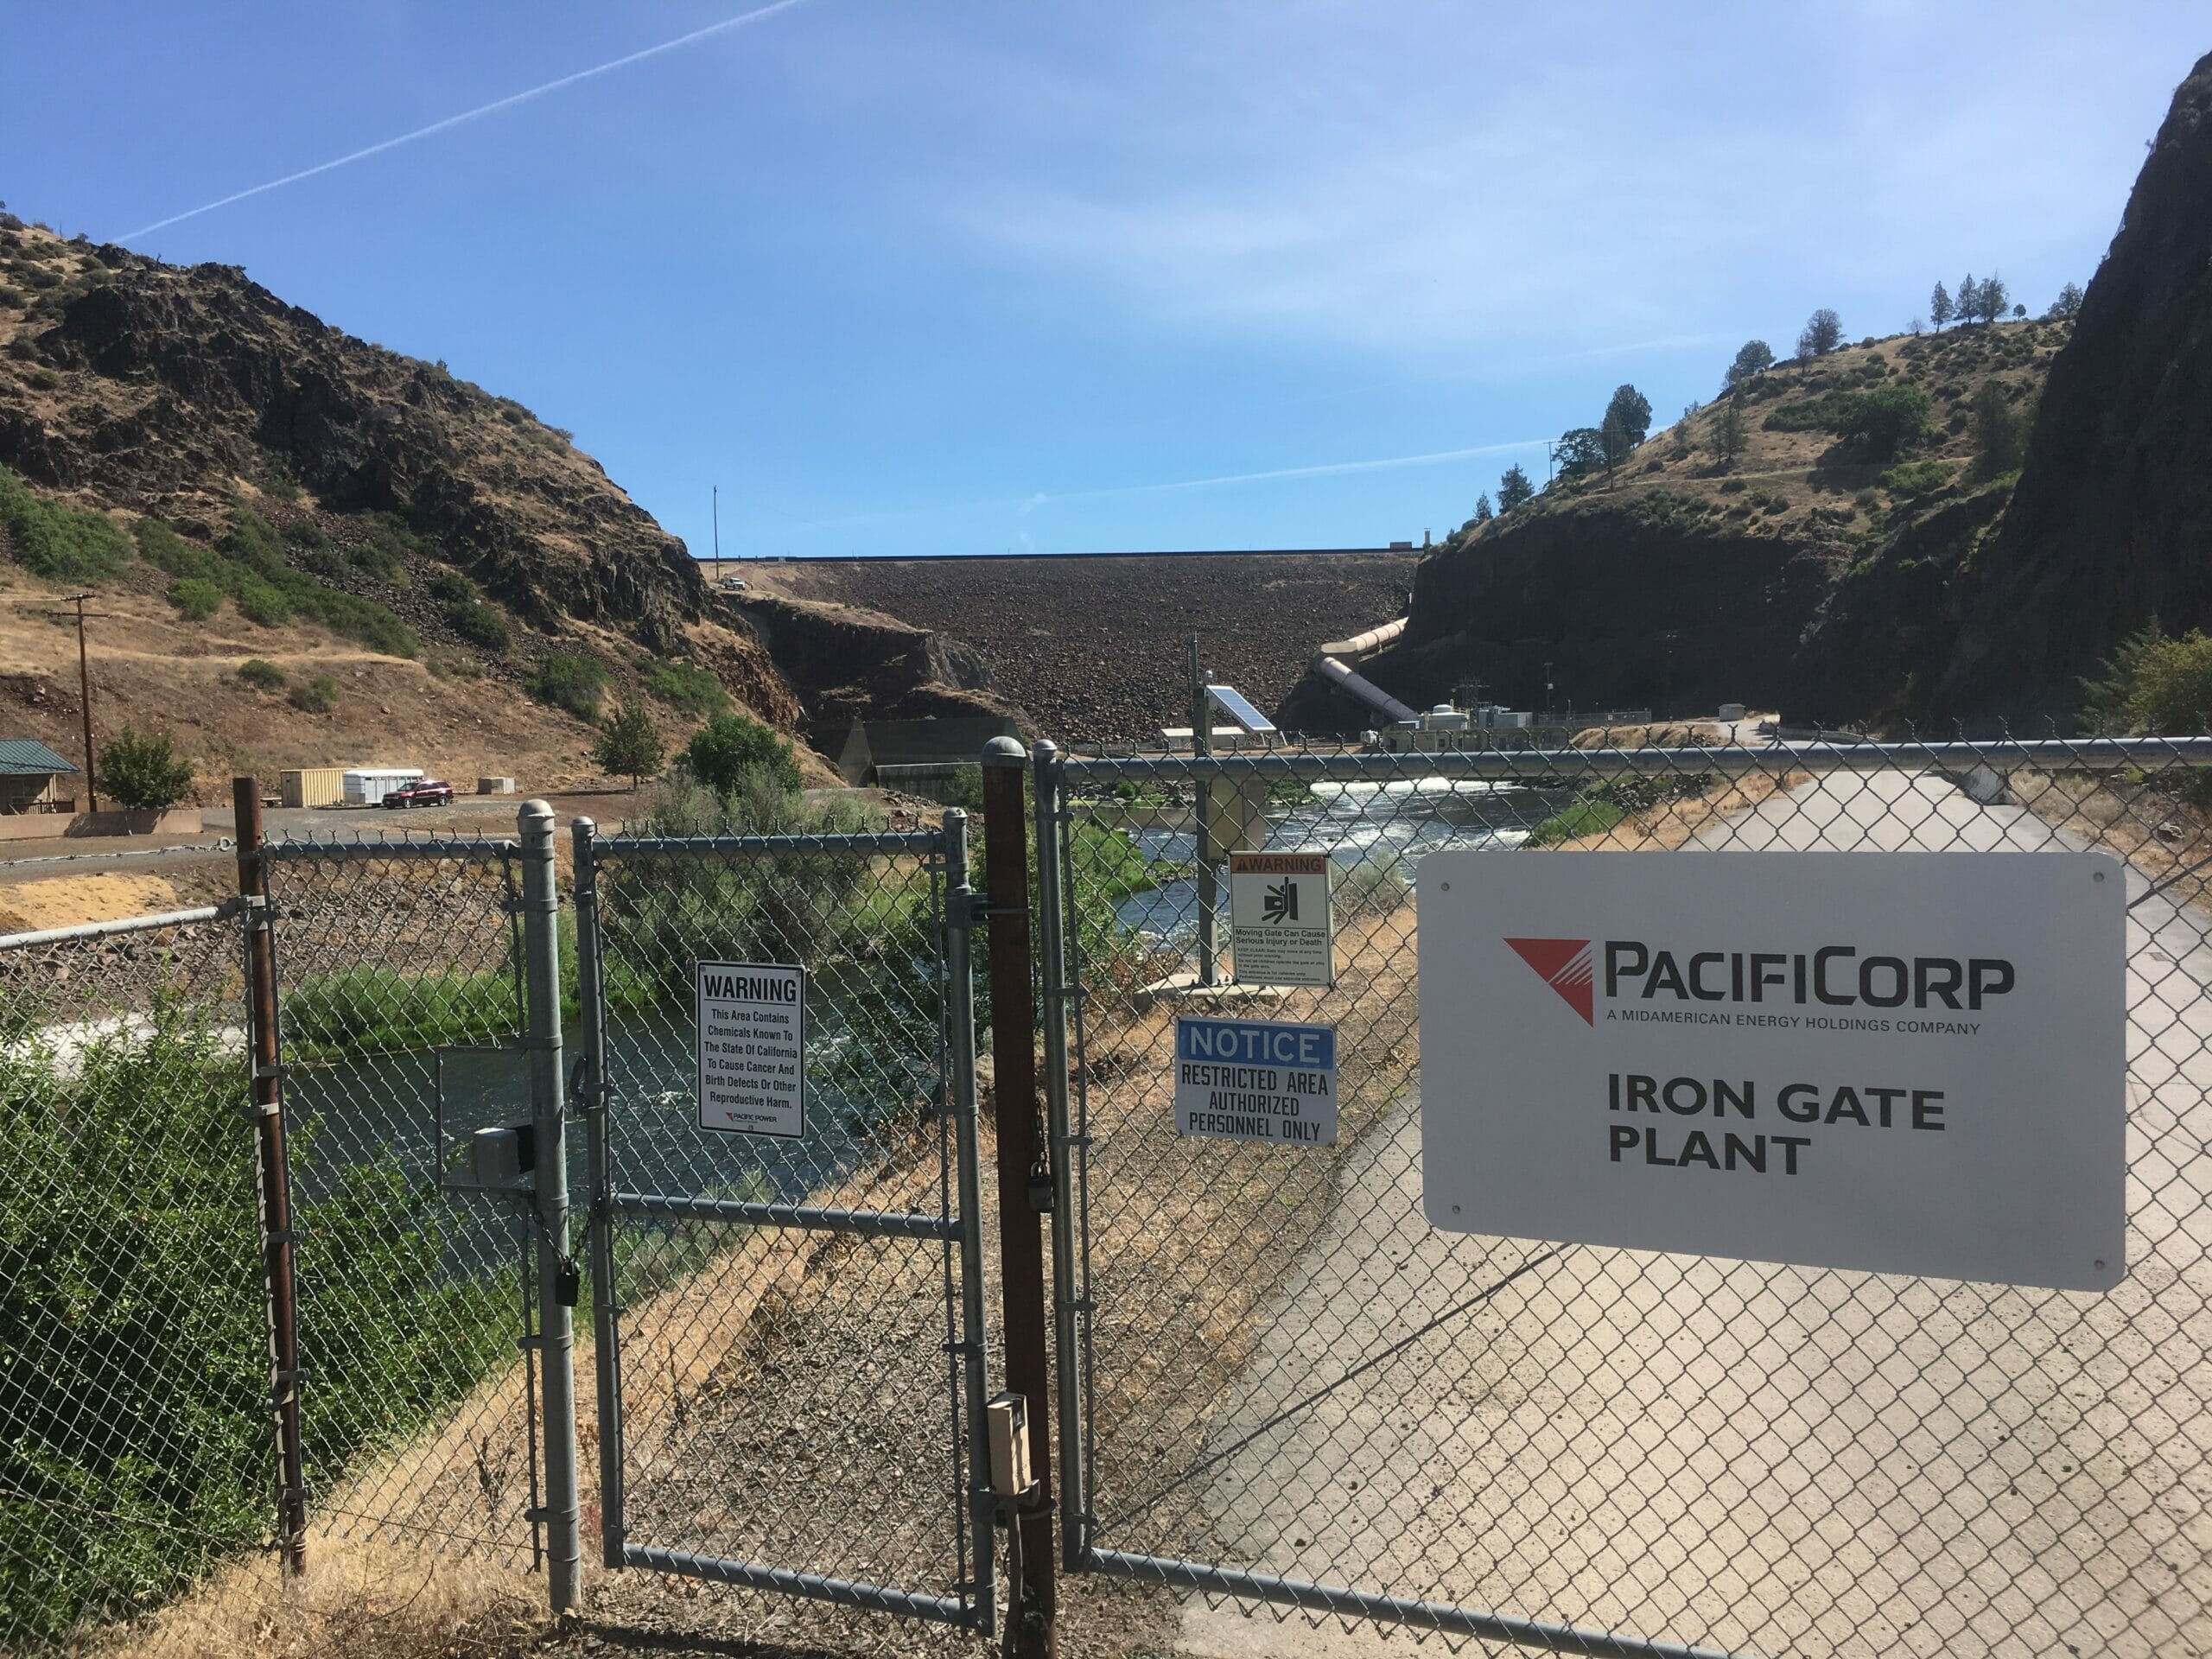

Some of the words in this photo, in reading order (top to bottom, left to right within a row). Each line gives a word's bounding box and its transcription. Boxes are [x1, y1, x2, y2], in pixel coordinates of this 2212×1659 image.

[1249, 858, 1321, 872] WARNING
[1266, 938, 1287, 946] Injury
[704, 975, 796, 1002] WARNING
[712, 1008, 729, 1020] This
[731, 1010, 750, 1021] Area
[753, 1011, 789, 1024] Contains
[1606, 1009, 1617, 1020] A
[1622, 1010, 1730, 1025] MIDAMERICAN
[1737, 1014, 1800, 1028] ENERGY
[1806, 1017, 1891, 1032] HOLDINGS
[1897, 1020, 1981, 1035] COMPANY
[709, 1025, 751, 1038] Chemicals
[753, 1028, 780, 1040] Known
[784, 1030, 793, 1041] To
[704, 1041, 719, 1052] The
[722, 1042, 743, 1054] State
[746, 1044, 754, 1055] Of
[758, 1045, 798, 1058] California
[1191, 1027, 1319, 1064] NOTICE
[708, 1058, 716, 1069] To
[719, 1059, 744, 1071] Cause
[747, 1061, 776, 1073] Cancer
[779, 1064, 795, 1075] And
[705, 1074, 725, 1085] Birth
[728, 1077, 759, 1089] Defects
[761, 1079, 771, 1090] Or
[773, 1080, 796, 1092] Other
[1182, 1064, 1277, 1090] RESTRICTED
[1287, 1071, 1328, 1096] AREA
[710, 1091, 764, 1106] Reproductive
[766, 1096, 792, 1109] Harm.
[1209, 1091, 1300, 1116] AUTHORIZED
[1608, 1074, 1755, 1119] IRON
[1777, 1083, 1946, 1131] GATE
[733, 1112, 754, 1121] PACIFIC
[755, 1115, 778, 1123] POWER
[1190, 1112, 1273, 1137] PERSONNEL
[1282, 1120, 1320, 1141] ONLY
[1609, 1125, 1811, 1176] PLANT
